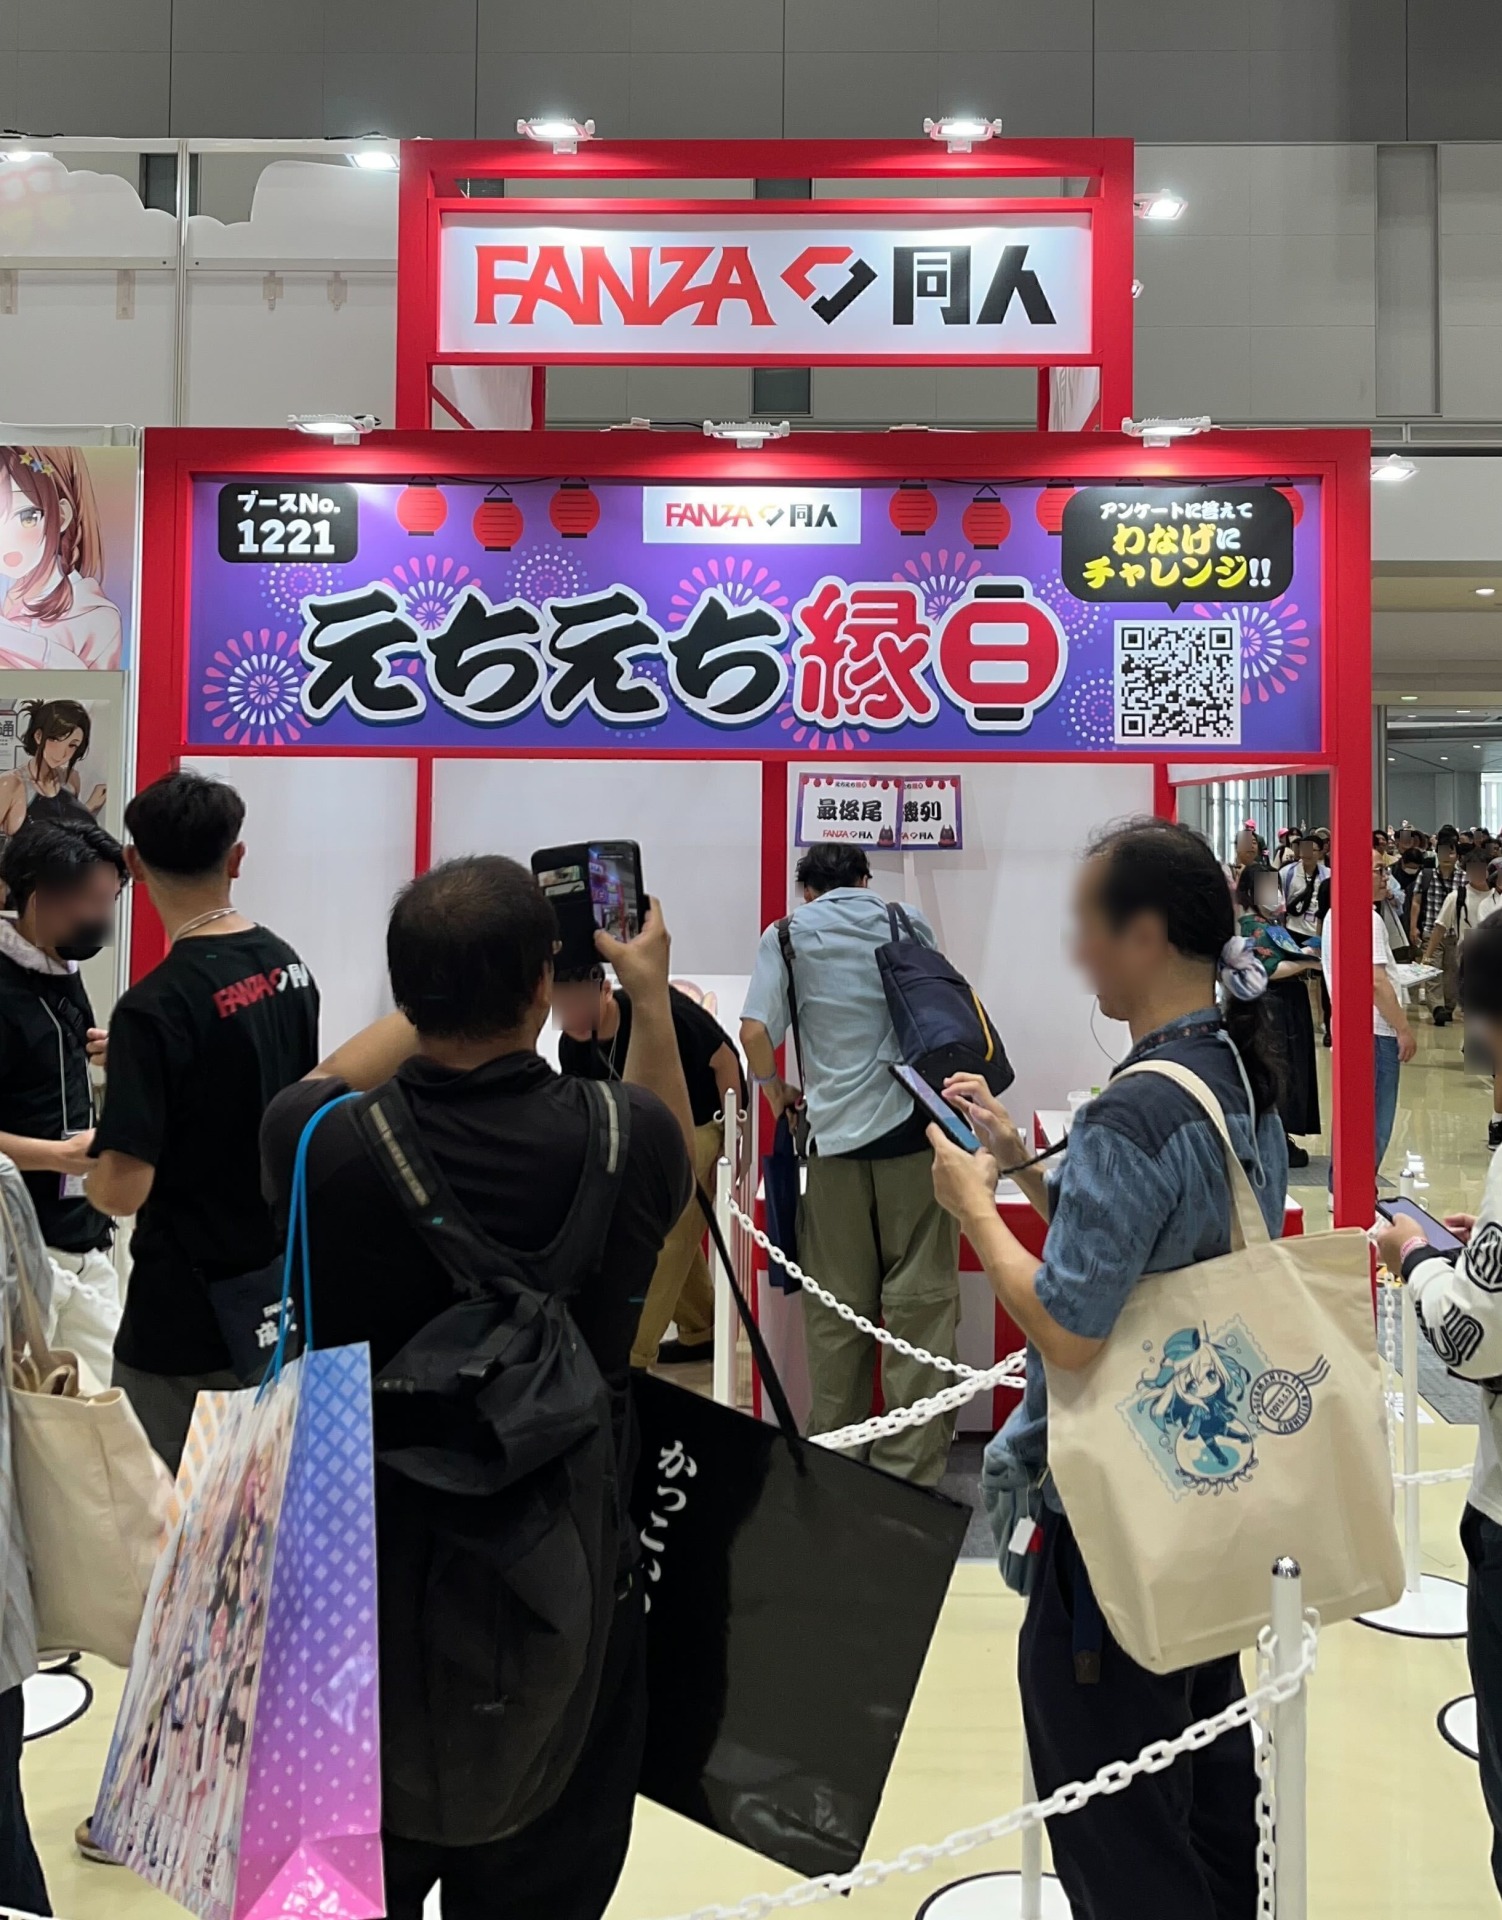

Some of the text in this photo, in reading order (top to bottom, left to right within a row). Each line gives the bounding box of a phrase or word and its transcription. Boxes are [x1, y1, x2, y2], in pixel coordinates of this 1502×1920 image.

[473, 244, 1057, 326] FANZA 同人
[236, 489, 341, 514] ブースNo.
[665, 502, 838, 528] FANZA 同人
[1099, 500, 1254, 520] アンケートに答えて
[237, 518, 336, 554] 1221
[1112, 522, 1241, 555] わなげに
[302, 580, 1066, 728] えちえち縁日
[816, 798, 882, 822] 最後尾
[822, 829, 849, 838] FANZA
[212, 973, 275, 1018] FANZA
[639, 1439, 698, 1614] かっこ
